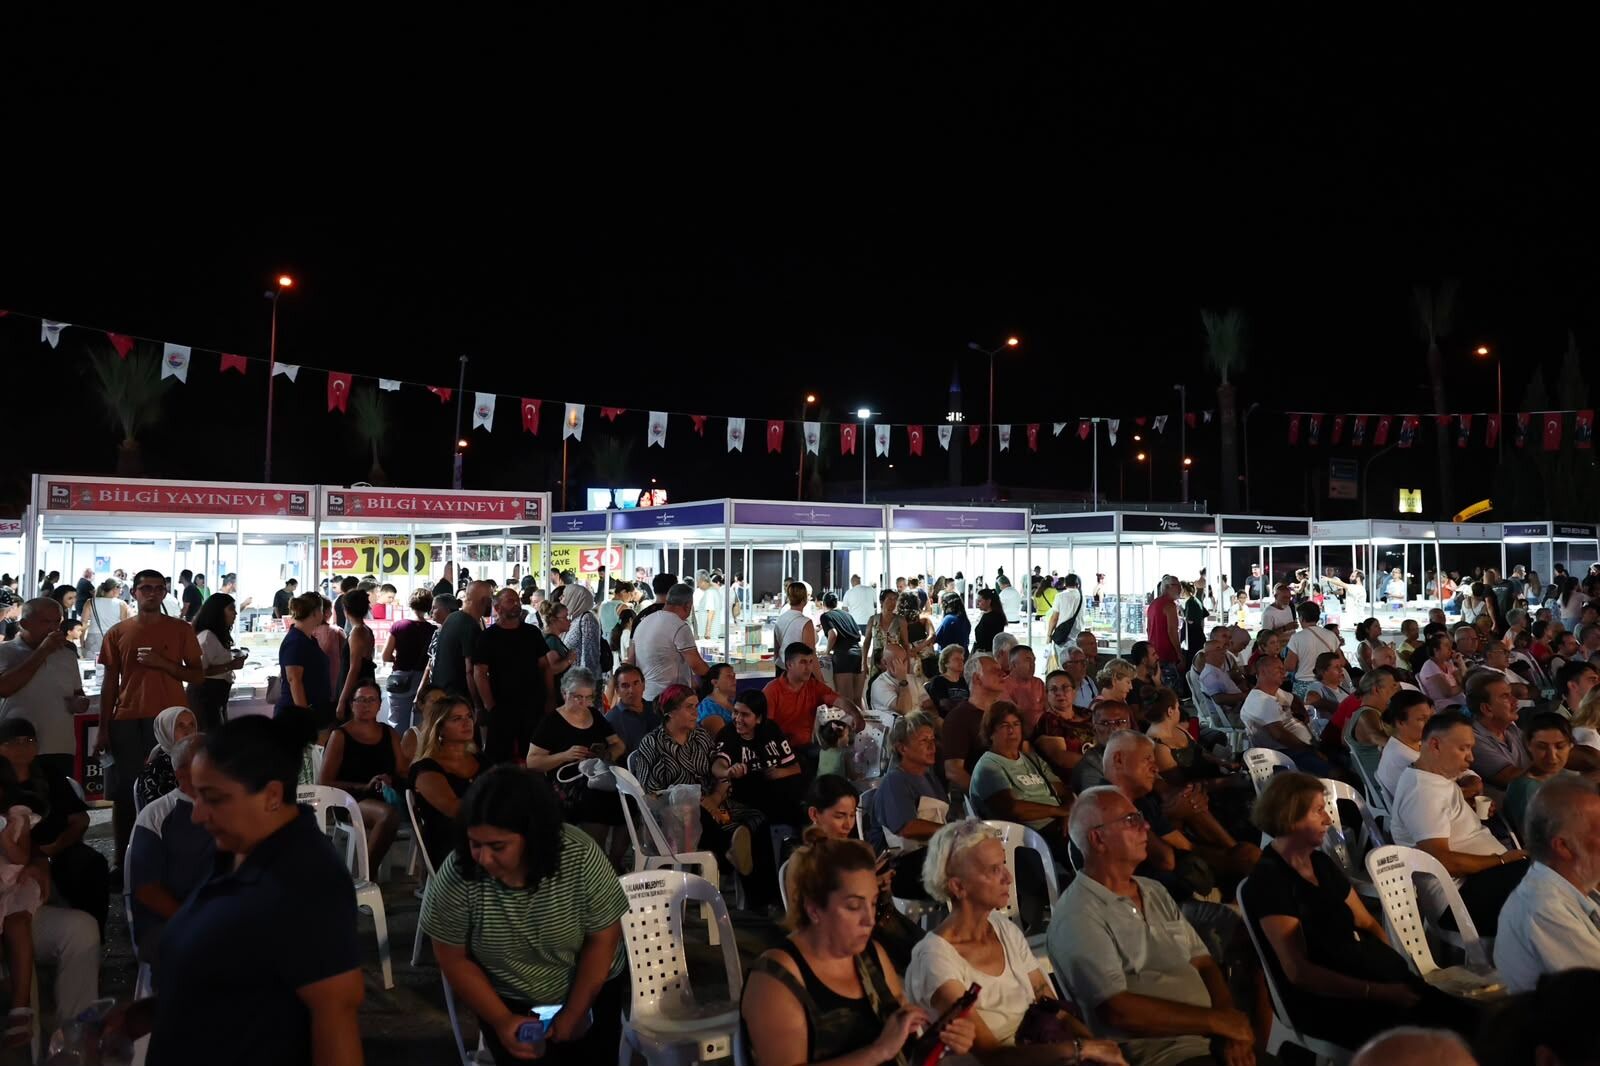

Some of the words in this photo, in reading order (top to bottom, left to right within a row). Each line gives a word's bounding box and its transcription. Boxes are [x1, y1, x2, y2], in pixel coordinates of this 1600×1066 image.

[99, 487, 160, 504] BİLGİ
[166, 491, 266, 507] YAYINEVİ
[367, 494, 417, 511] BİLGİ
[422, 498, 506, 513] YAYINEVİ
[322, 559, 352, 567] KTAP
[333, 550, 343, 560] 4
[361, 547, 425, 573] 100
[582, 548, 620, 571] 30
